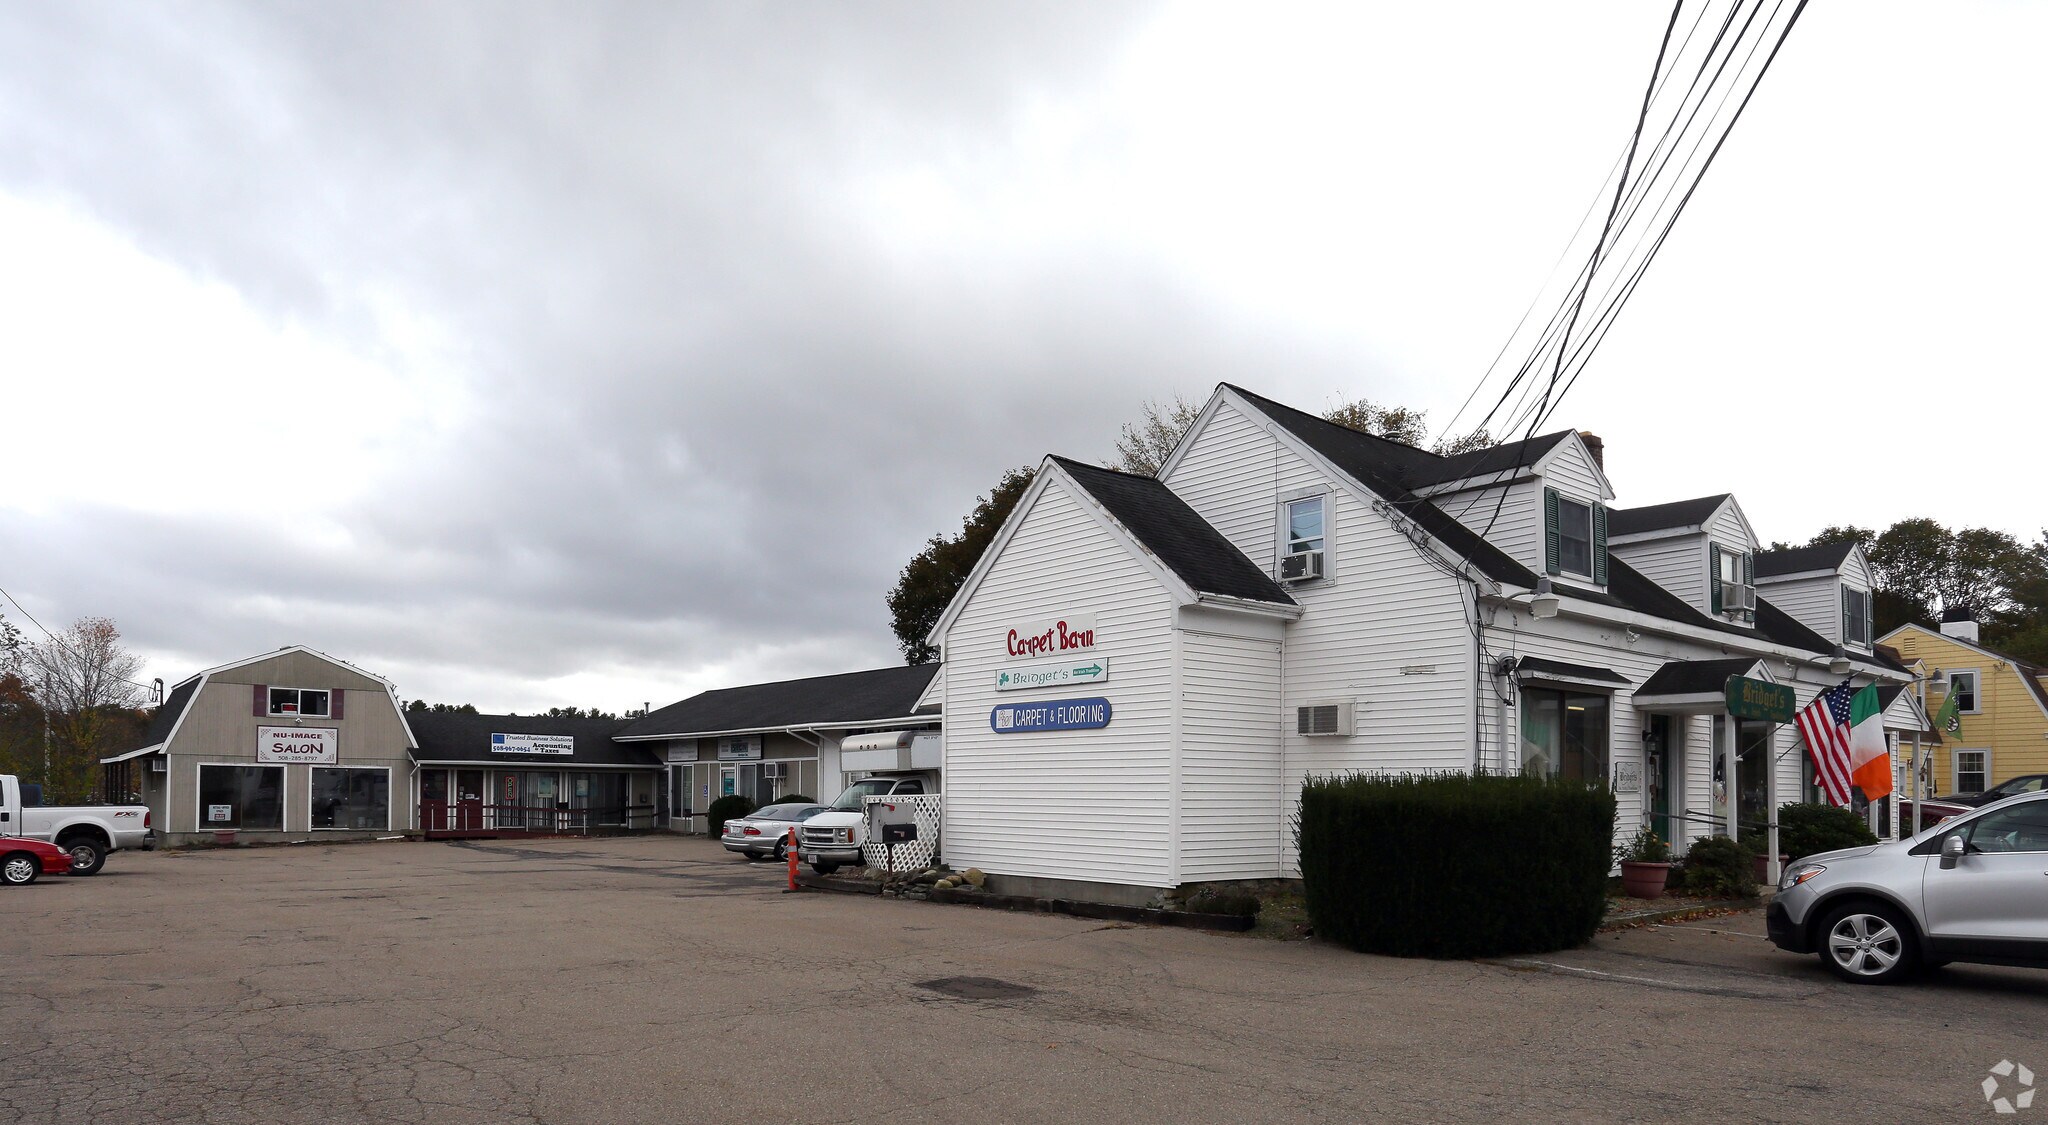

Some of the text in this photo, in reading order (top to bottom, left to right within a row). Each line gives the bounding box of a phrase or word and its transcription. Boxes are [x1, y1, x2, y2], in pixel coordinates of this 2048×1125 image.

[1007, 620, 1094, 657] Carpet Barn
[1013, 669, 1069, 685] Bridget's
[1743, 680, 1785, 709] Bridget's
[1015, 704, 1104, 727] CARPET & FLOORING
[273, 732, 323, 740] NU-IMAGE
[272, 742, 323, 754] SALON
[532, 742, 572, 750] Accounting
